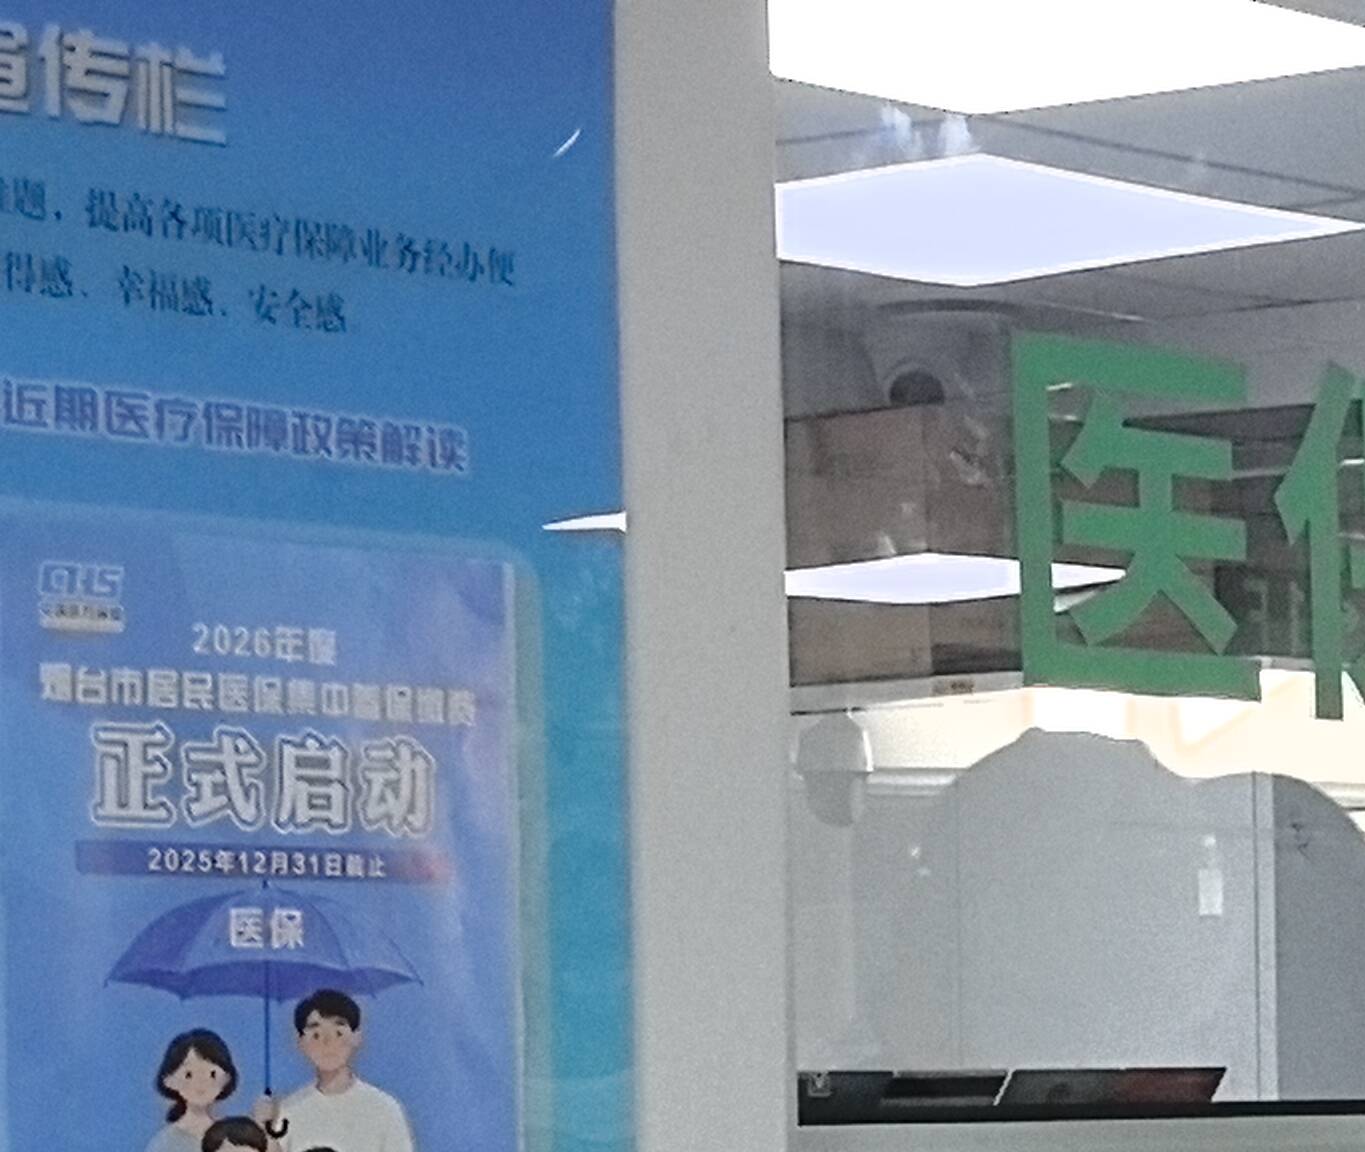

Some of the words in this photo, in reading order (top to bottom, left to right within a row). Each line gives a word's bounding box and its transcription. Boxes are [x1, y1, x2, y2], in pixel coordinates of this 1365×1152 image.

[0, 176, 514, 286] 题，提高各项医疗保障业务经办便
[3, 378, 468, 474] 近期医疗保障政策解读
[191, 622, 337, 666] 2026年度
[90, 721, 438, 838] 正式启动
[147, 846, 387, 878] 2025年12月31日截止
[229, 906, 304, 949] 医保
